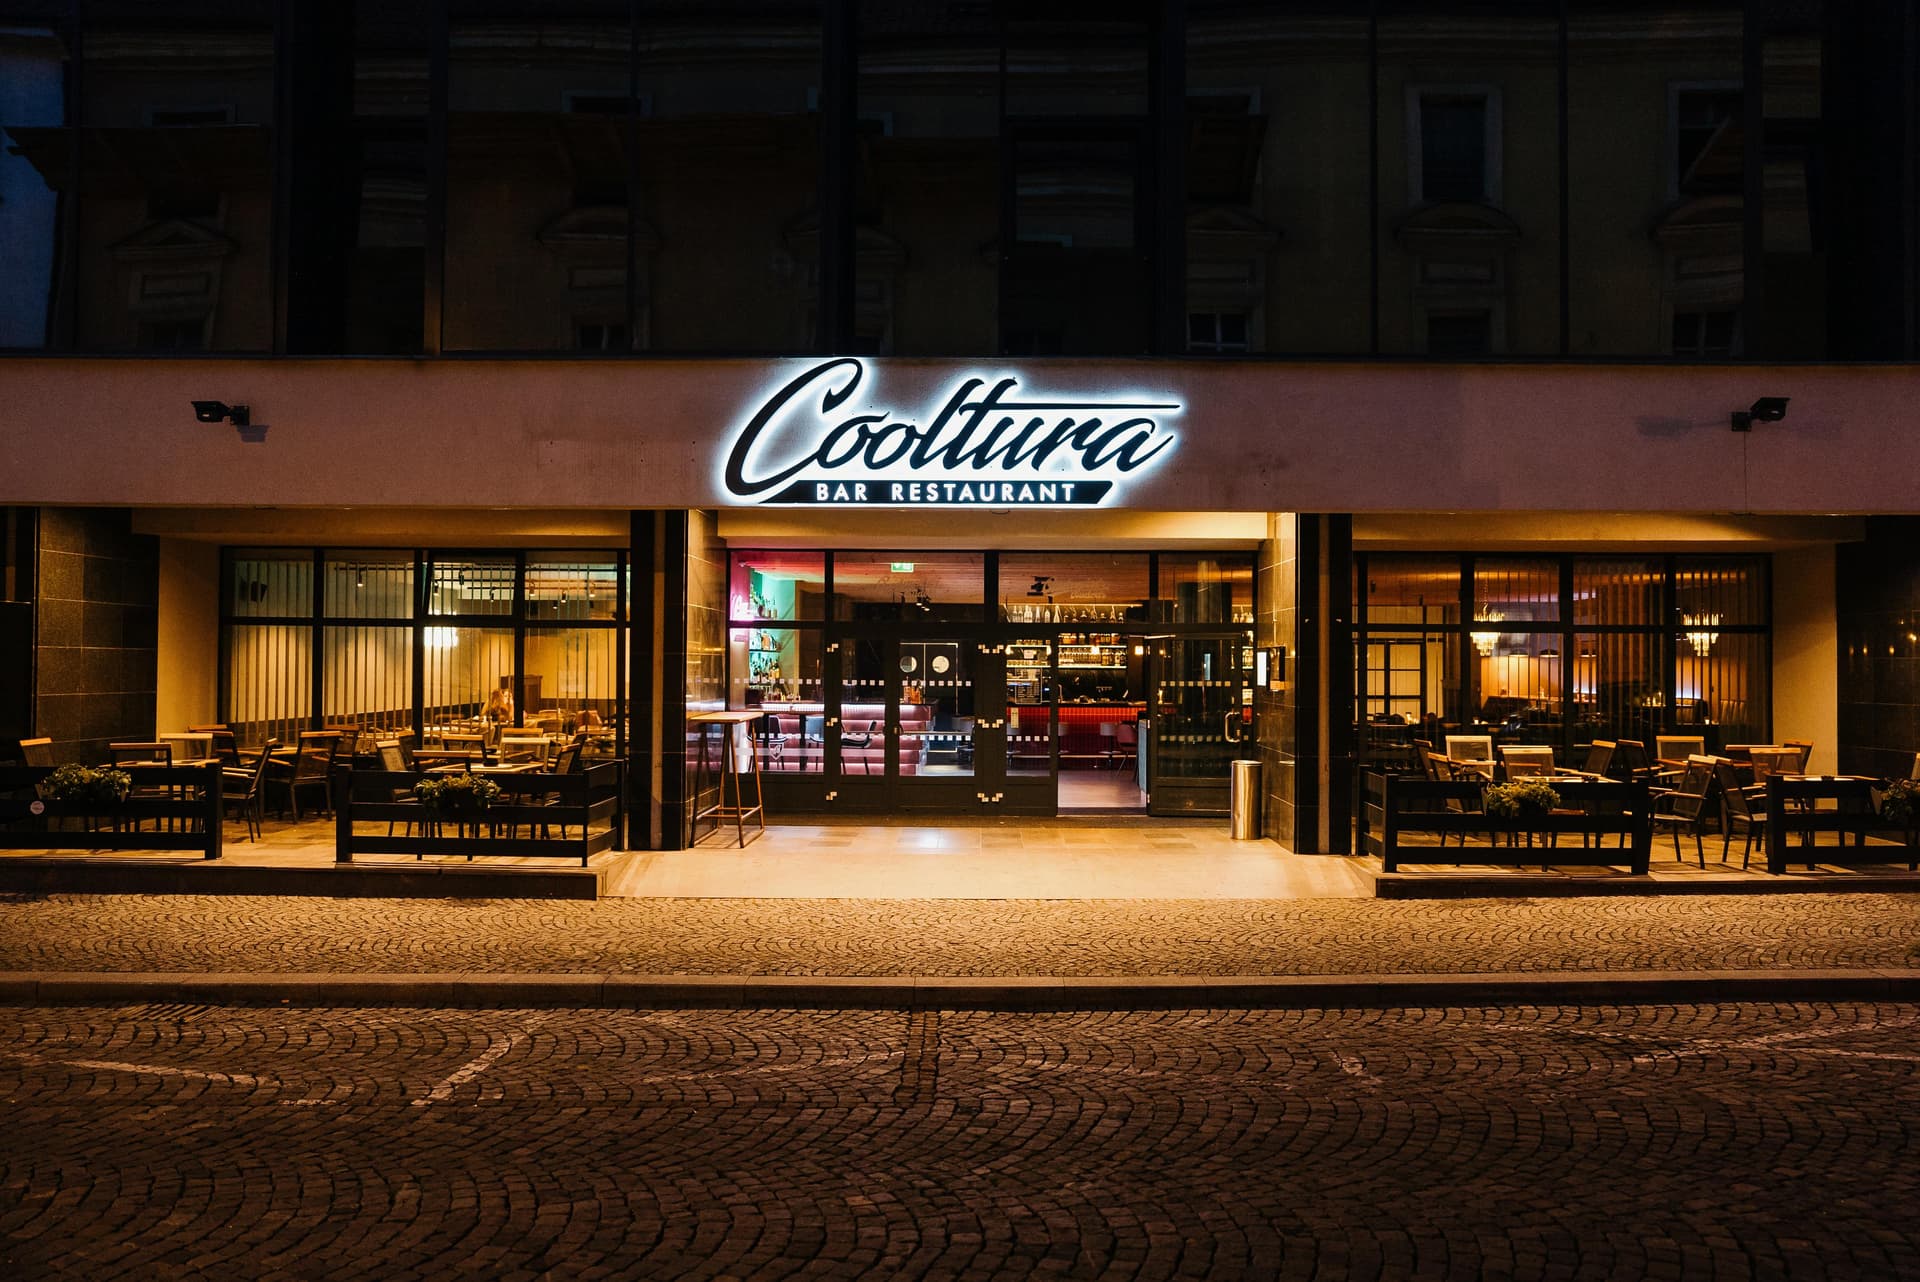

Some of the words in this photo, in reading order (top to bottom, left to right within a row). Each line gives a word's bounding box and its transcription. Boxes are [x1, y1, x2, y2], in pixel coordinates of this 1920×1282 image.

[725, 358, 1180, 496] Cooltura
[816, 483, 867, 501] BAR
[891, 483, 1075, 501] RESTAURANT
